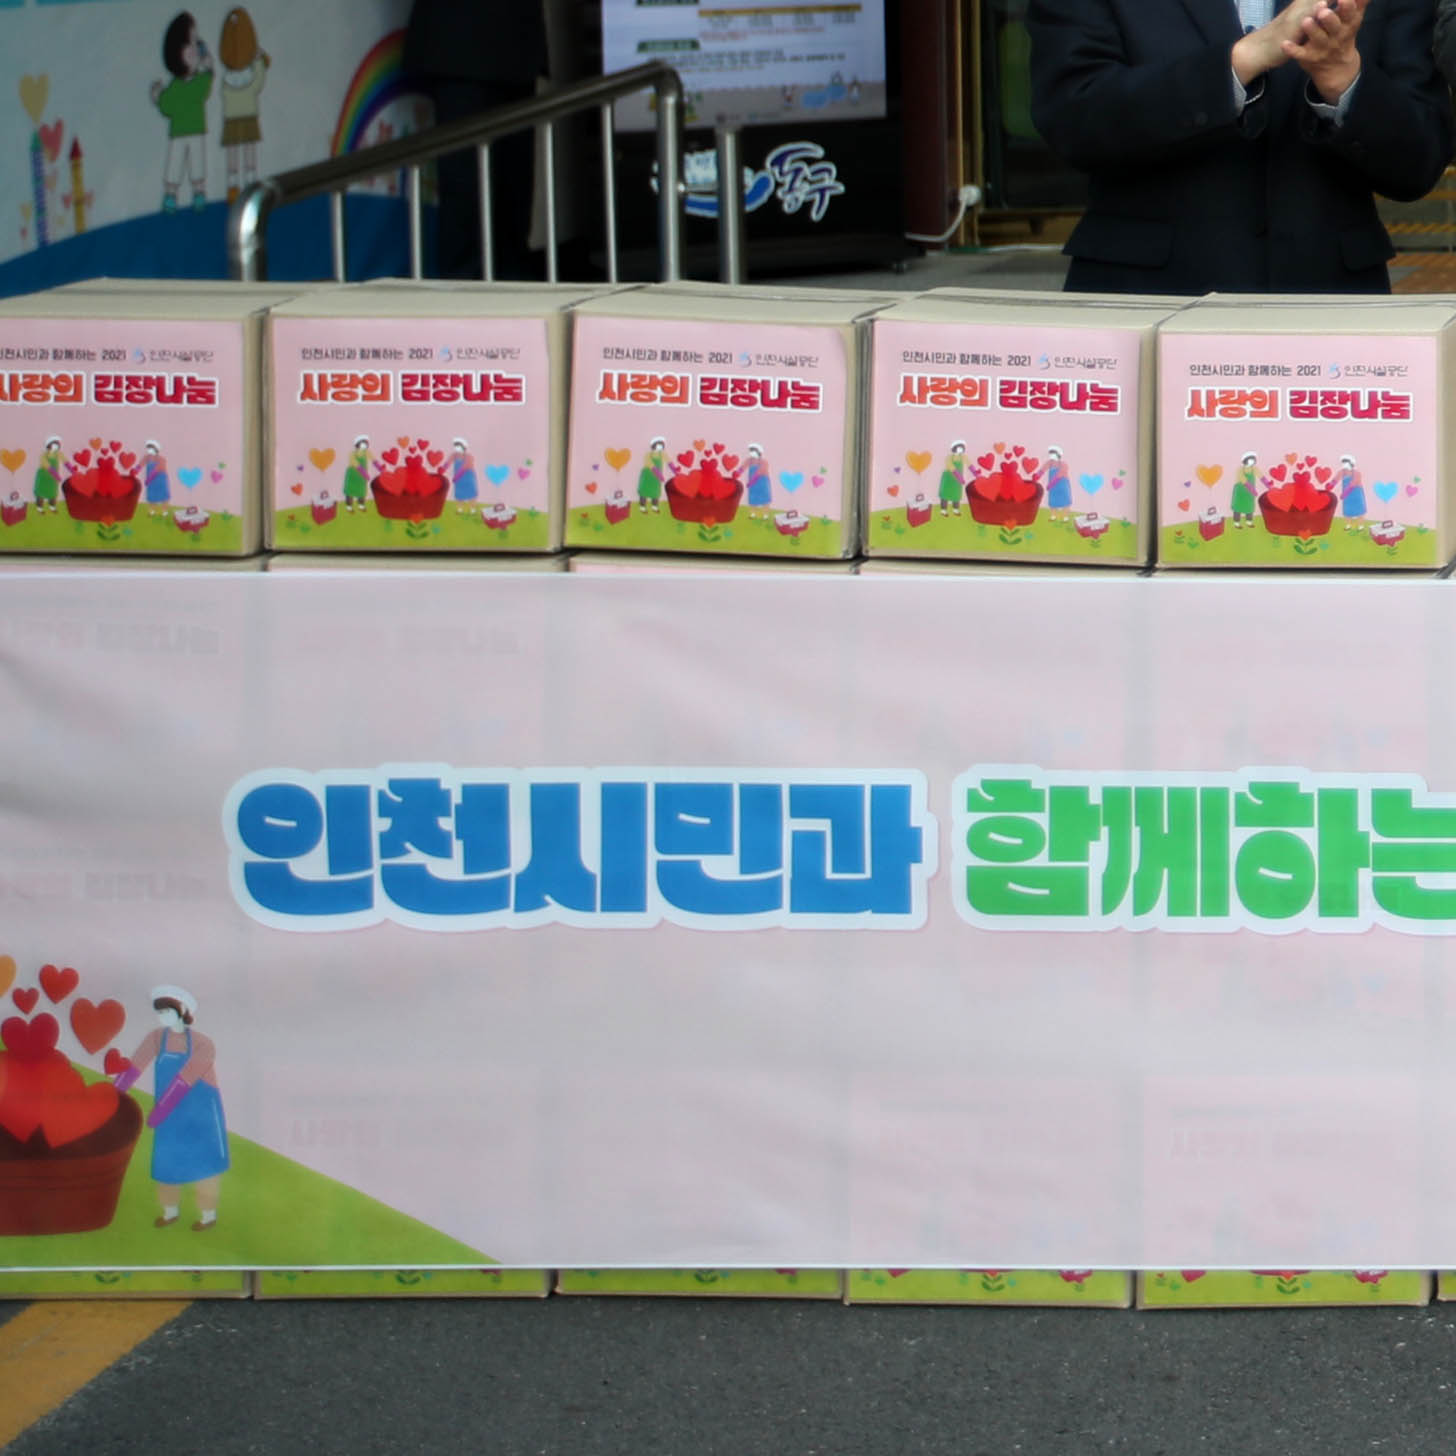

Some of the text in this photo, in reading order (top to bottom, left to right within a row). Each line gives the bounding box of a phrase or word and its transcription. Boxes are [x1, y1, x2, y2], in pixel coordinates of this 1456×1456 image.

[0, 347, 127, 362] 천시민과 함께하는 2021
[301, 347, 434, 361] 인천시민과 함께하는 2021
[602, 347, 733, 365] 인천시민과 함께하는 2021
[902, 350, 1032, 367] 인천시민과 함께하는 2021
[1189, 363, 1322, 377] 인천시민과 함께하는 2021
[94, 374, 217, 405] 김장나눔
[301, 373, 523, 403] 사랑의 김장나눔
[599, 373, 821, 411] 사랑의 김장나눔
[900, 375, 1119, 413] 사랑의 김장나눔
[1187, 388, 1411, 420] 사랑의 김장나눔
[236, 777, 923, 917] 인천시민과
